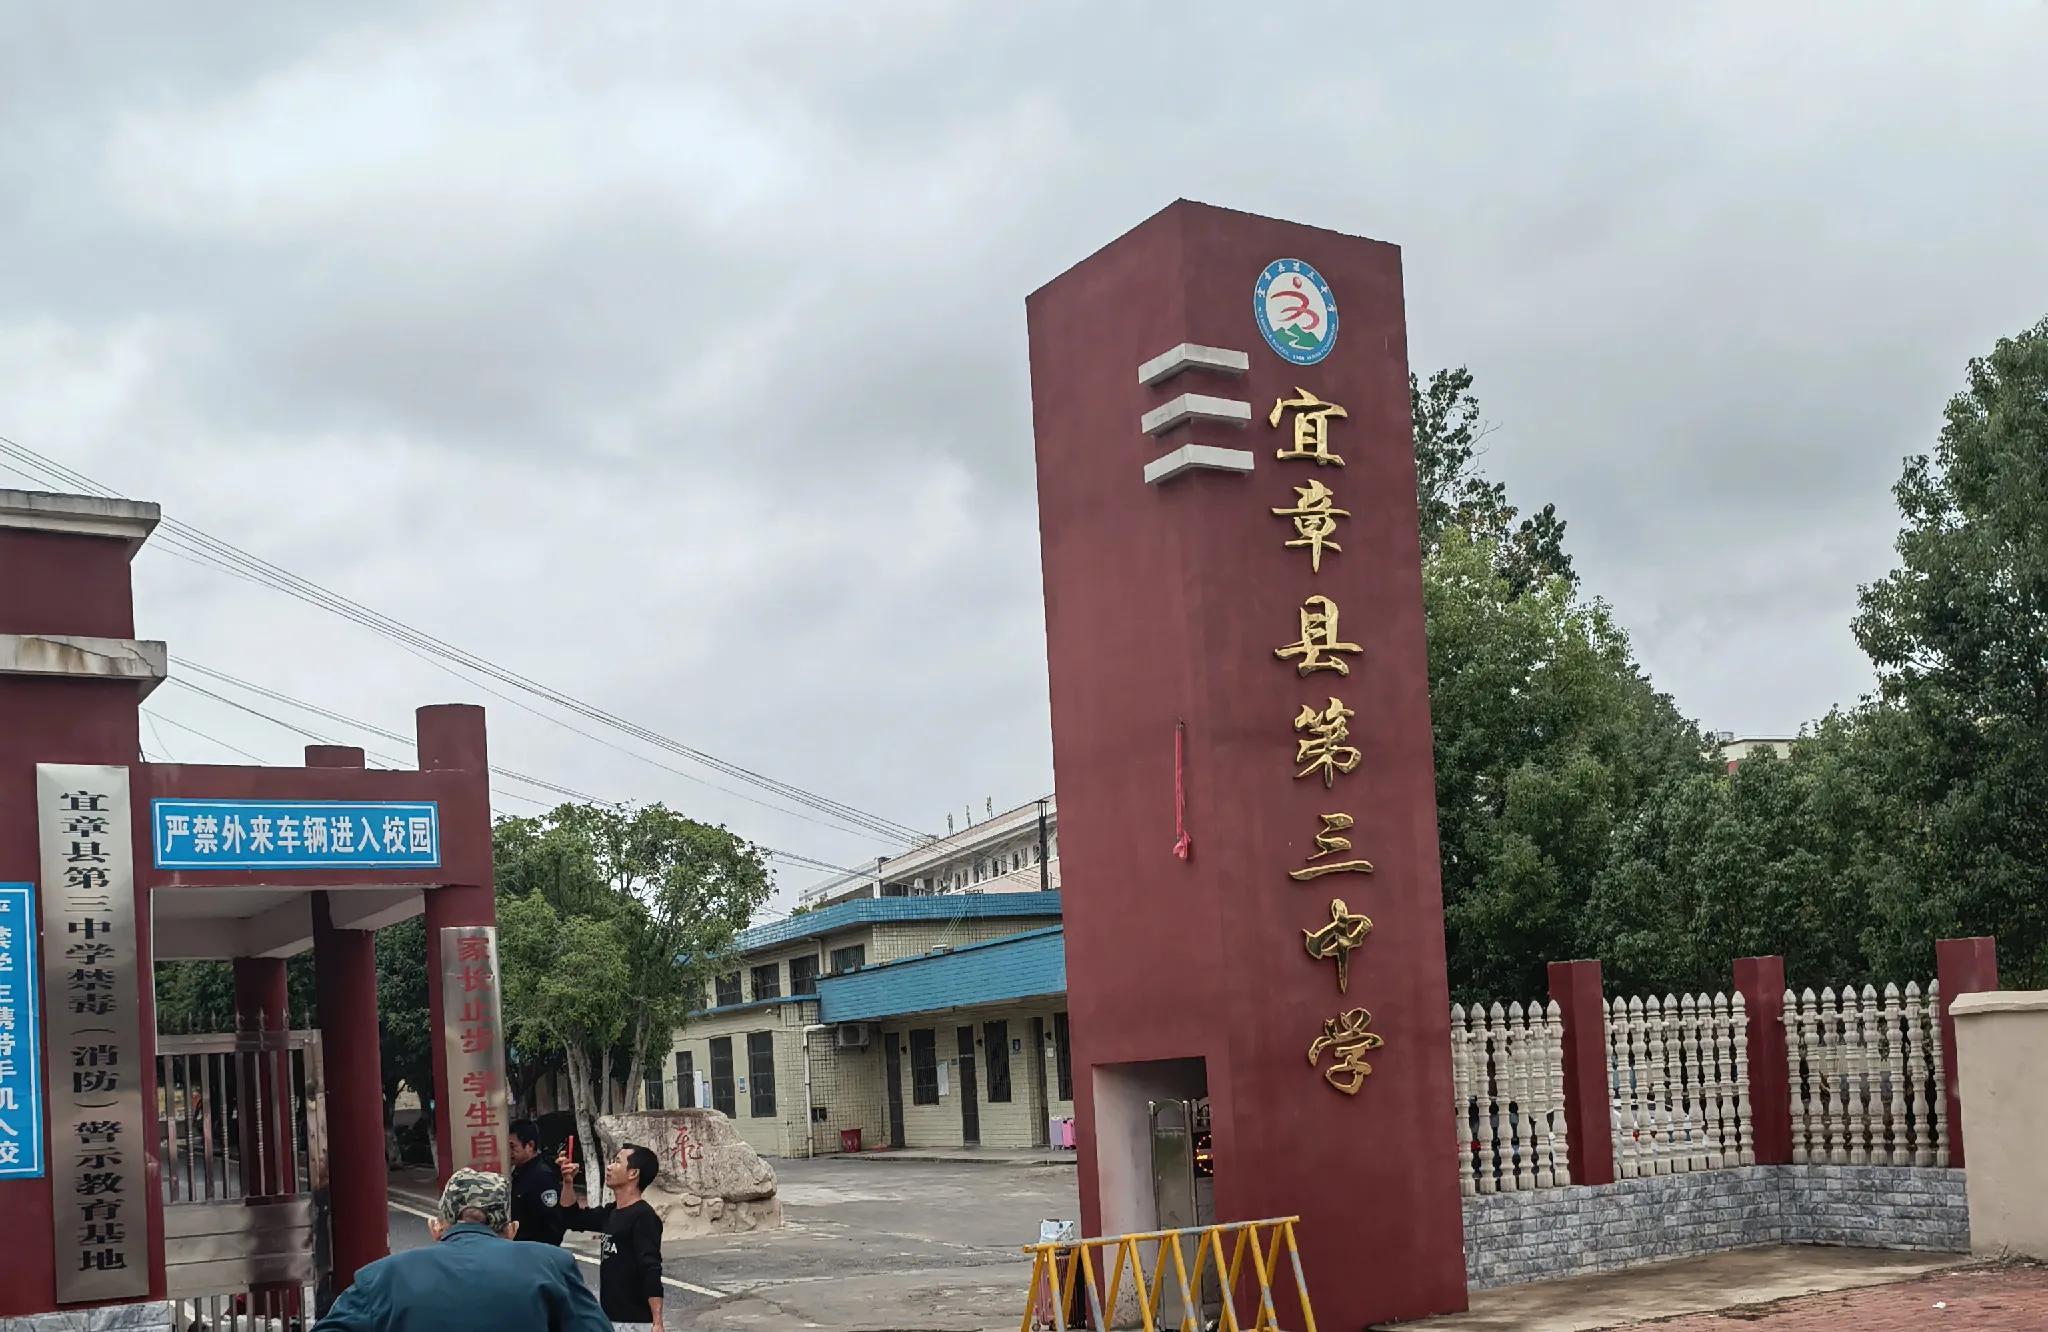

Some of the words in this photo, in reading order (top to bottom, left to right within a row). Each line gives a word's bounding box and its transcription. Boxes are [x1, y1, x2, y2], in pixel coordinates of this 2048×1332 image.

[1269, 386, 1385, 1096] 宜章县第三中学
[164, 814, 432, 854] 严禁外来车辆进入校园
[456, 936, 495, 1054] 家长止步
[463, 1071, 503, 1173] 学生自
